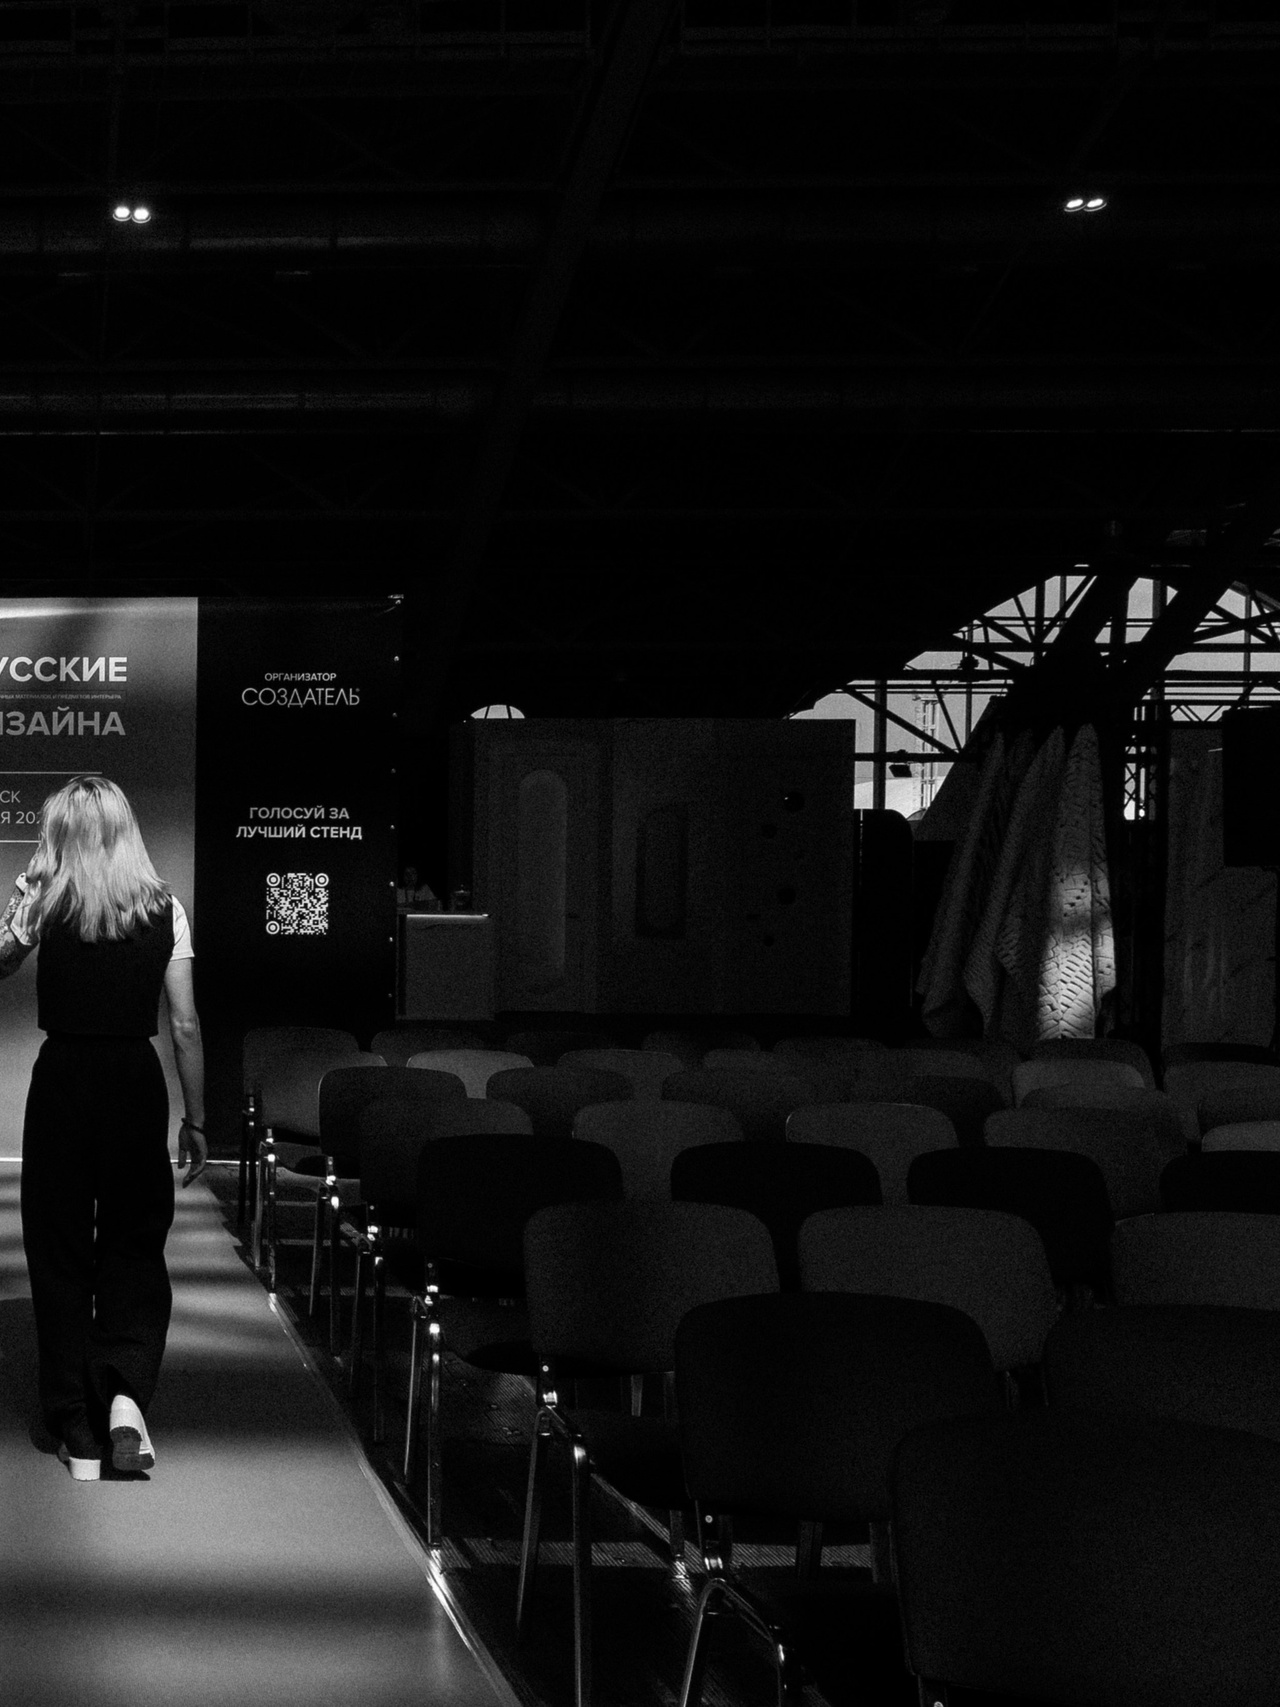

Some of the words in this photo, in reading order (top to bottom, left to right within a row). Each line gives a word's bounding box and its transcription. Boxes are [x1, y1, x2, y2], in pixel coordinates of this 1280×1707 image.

[264, 672, 337, 681] ОРГАНИЗАТОР
[241, 687, 361, 708] СОЗДАТЕЛЬ
[249, 805, 325, 820] ГОЛОСУЙ
[329, 807, 350, 819] ЗА
[236, 824, 307, 838] ЛУЧШИЙ
[310, 826, 363, 840] СТЕНД
